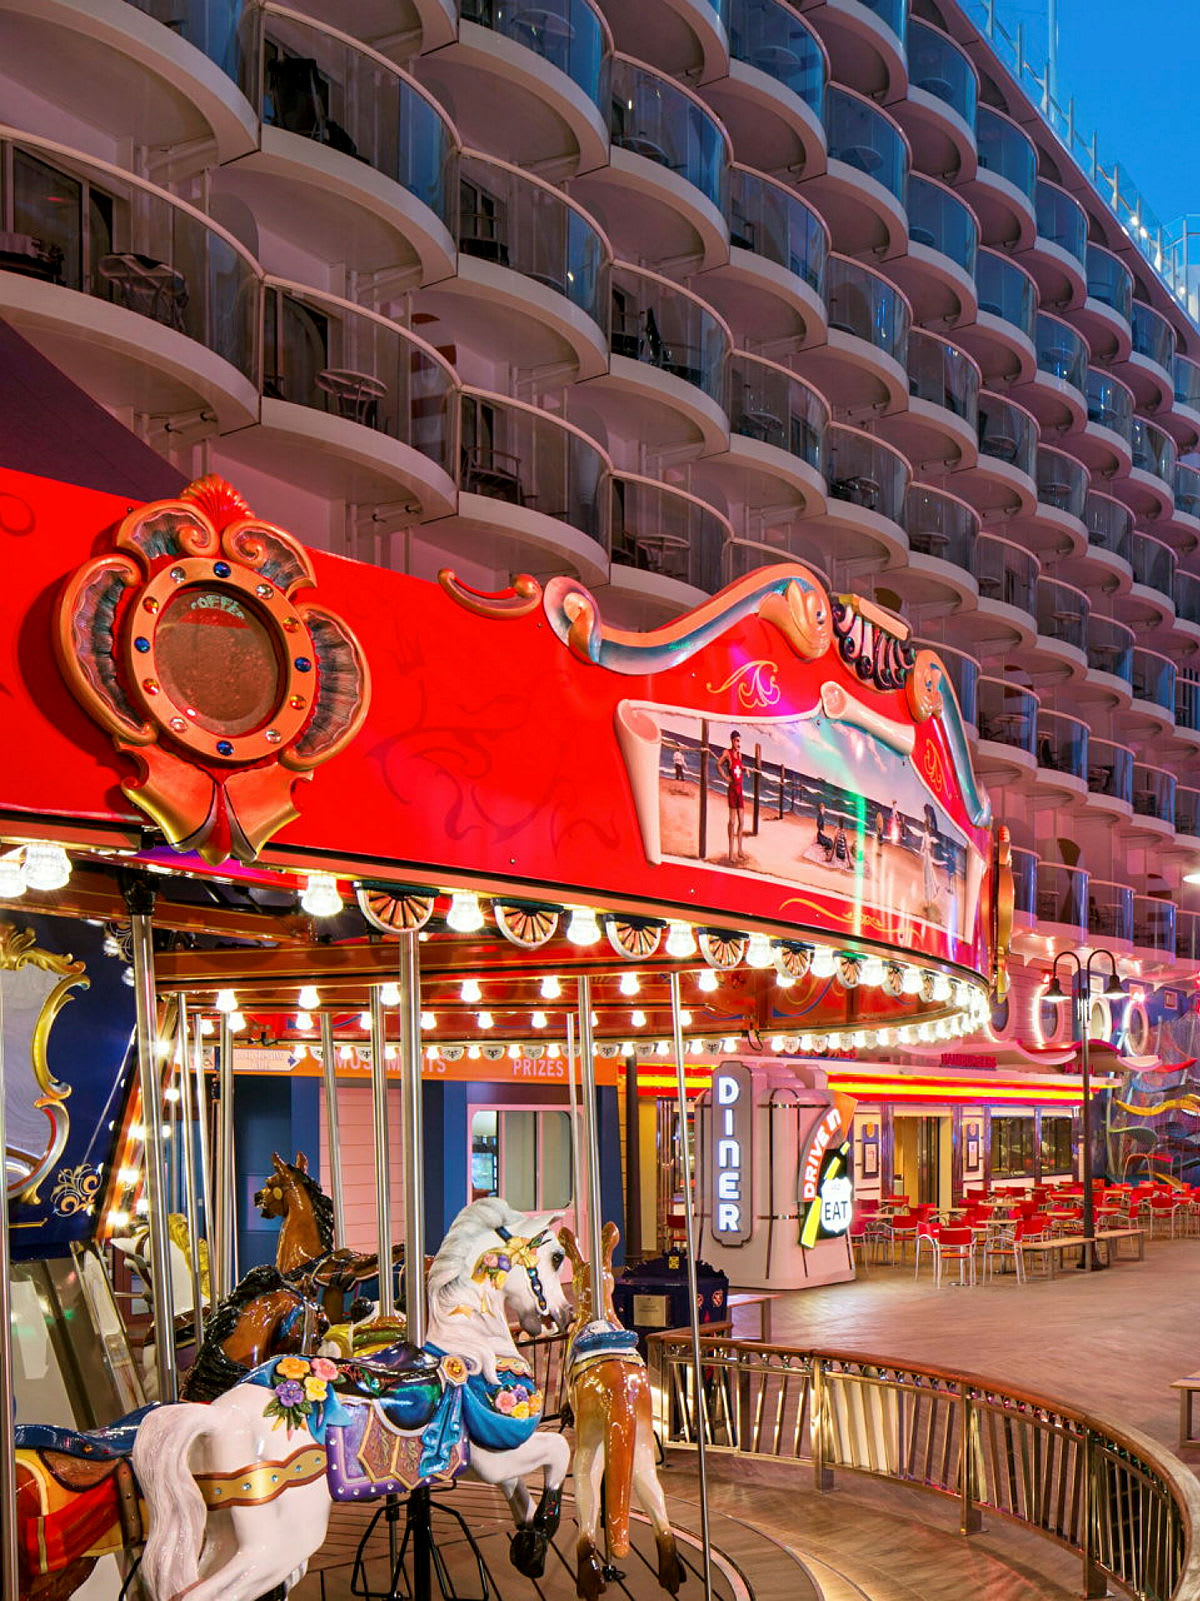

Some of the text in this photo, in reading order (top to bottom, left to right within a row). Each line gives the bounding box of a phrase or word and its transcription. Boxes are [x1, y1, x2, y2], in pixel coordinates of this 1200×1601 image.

[512, 1059, 564, 1077] PRIZES
[718, 1075, 741, 1232] DINER
[804, 1125, 830, 1199] DRIVE
[824, 1200, 848, 1221] EAT
